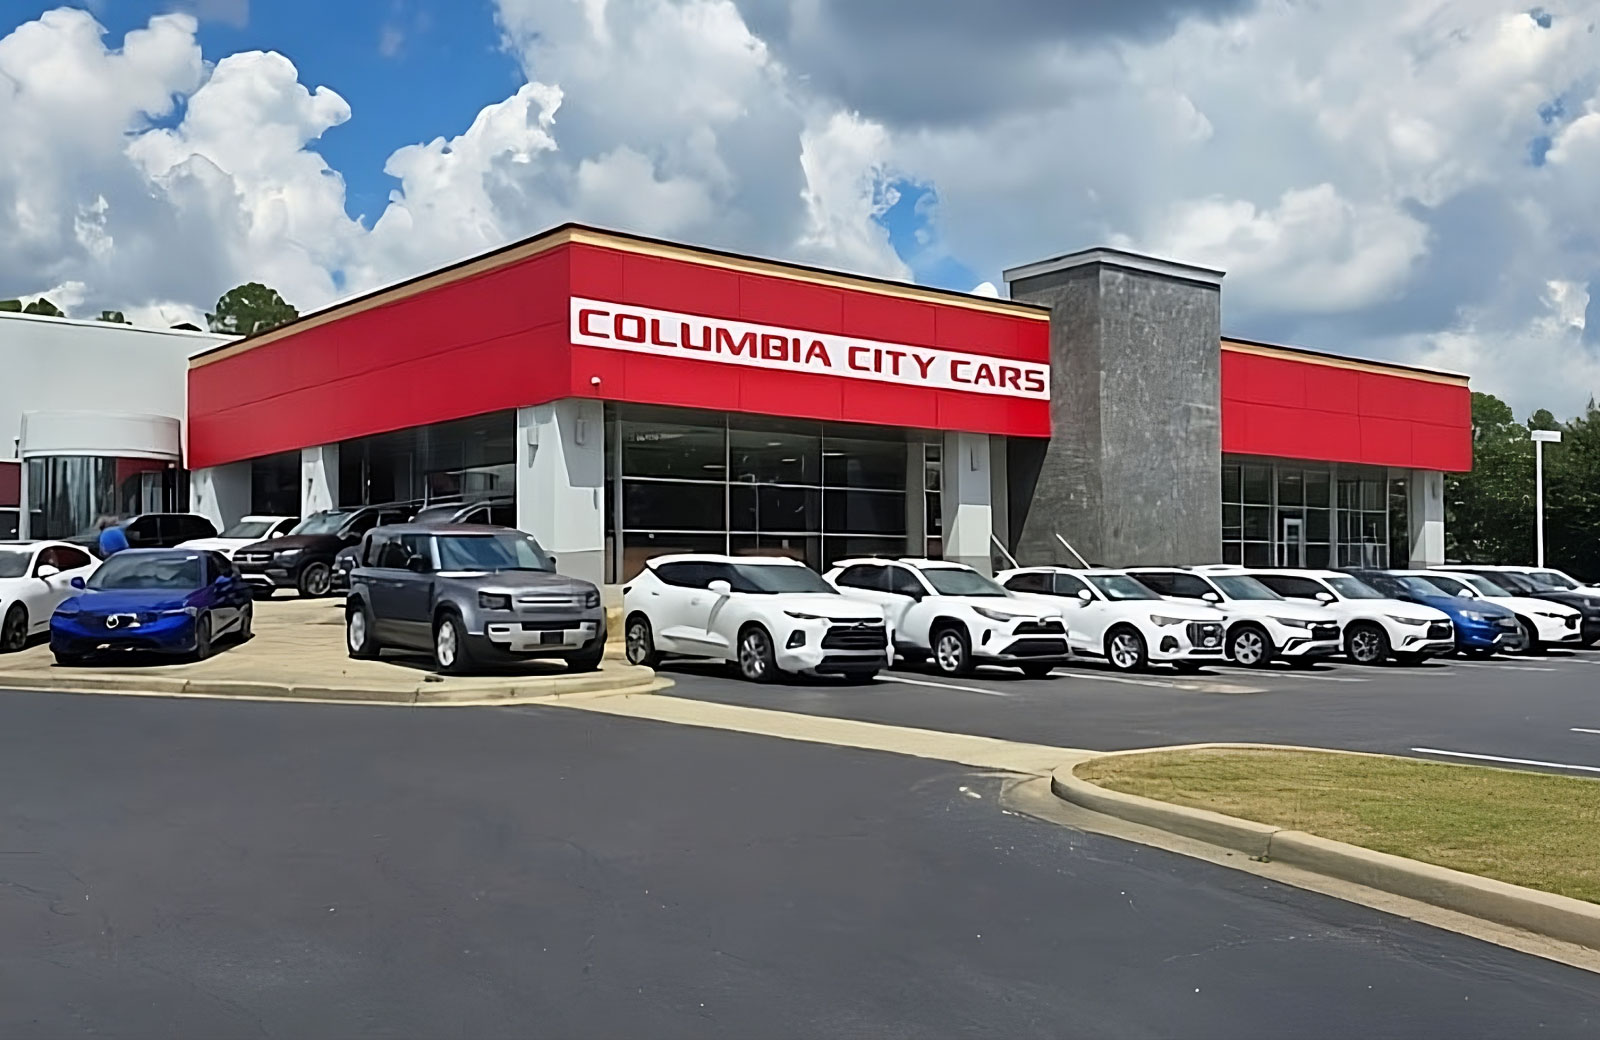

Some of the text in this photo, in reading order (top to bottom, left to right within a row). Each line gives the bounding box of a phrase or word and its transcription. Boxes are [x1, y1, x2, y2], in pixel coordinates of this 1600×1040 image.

[579, 309, 1045, 393] COLUMBIA CITY CARS
